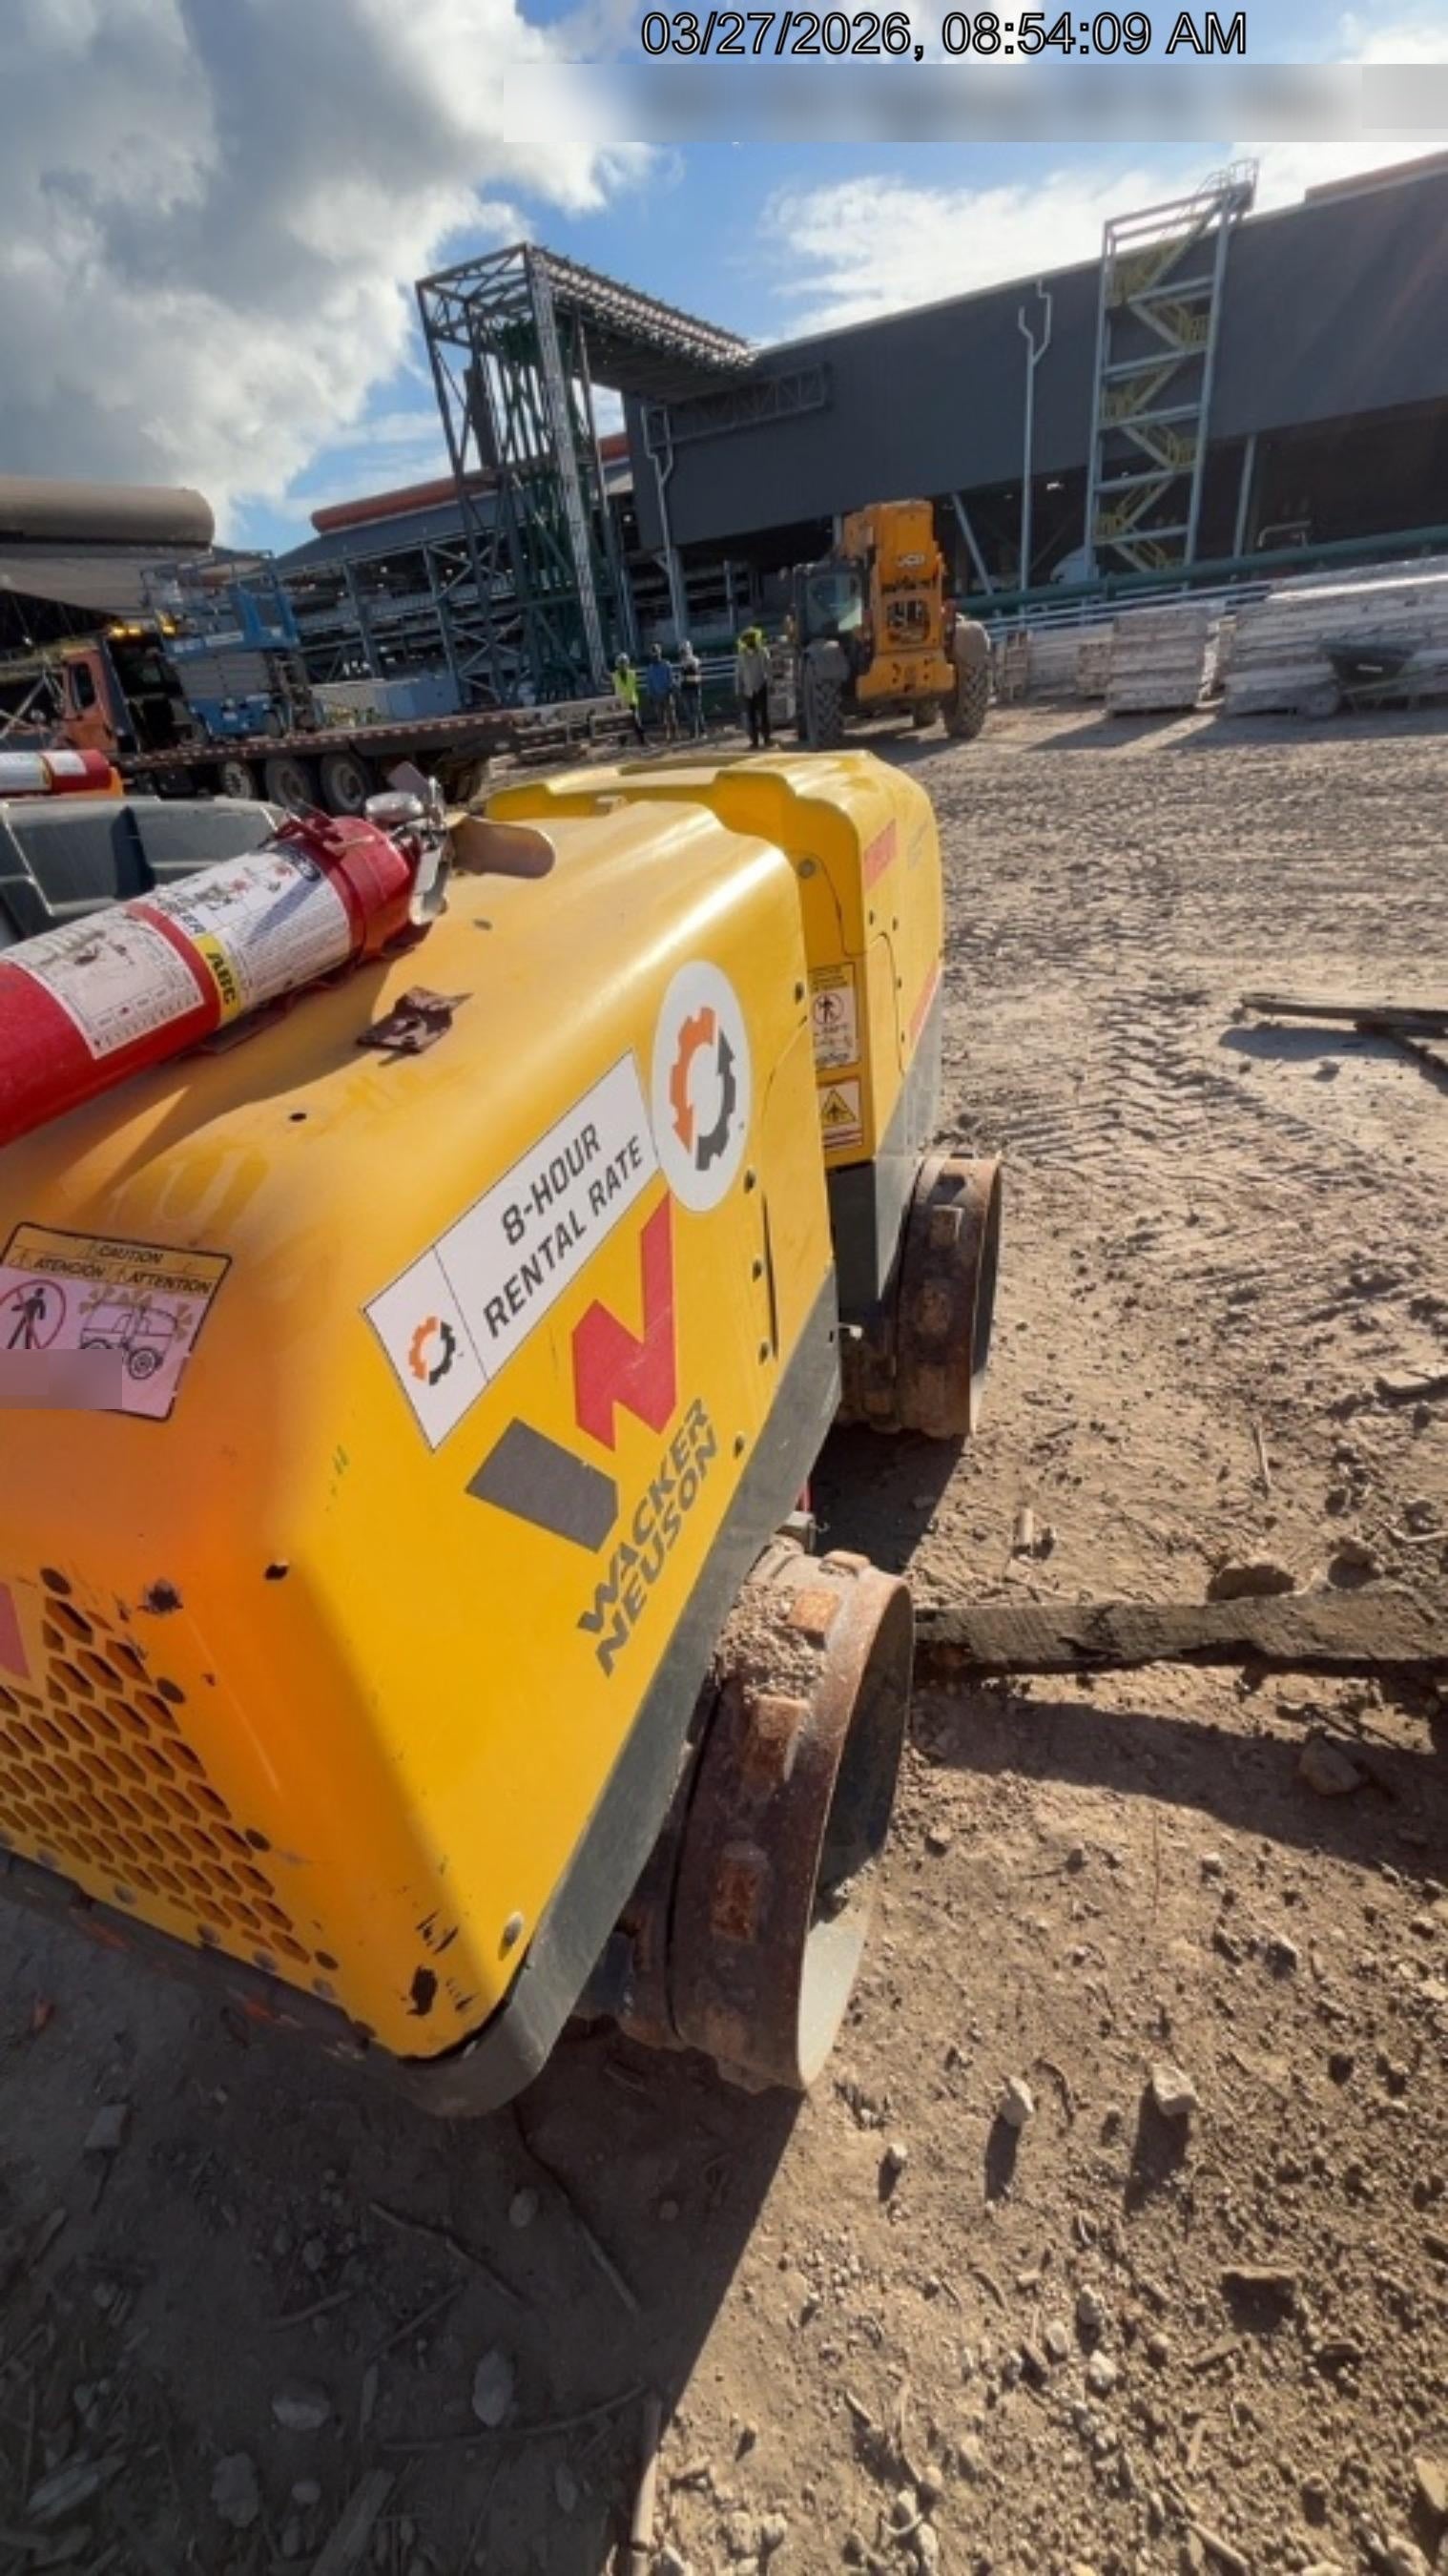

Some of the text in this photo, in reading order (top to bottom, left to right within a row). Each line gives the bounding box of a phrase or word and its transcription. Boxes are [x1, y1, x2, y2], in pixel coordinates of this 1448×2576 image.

[206, 952, 235, 1005] ABC
[484, 1135, 643, 1338] RENTAL RATE
[502, 1123, 601, 1245] 8-HOUR
[98, 1245, 163, 1264] CAUTION
[129, 1272, 213, 1294] ATTENTION
[577, 1399, 708, 1633] WACKER
[595, 1423, 717, 1678] NEUSON
